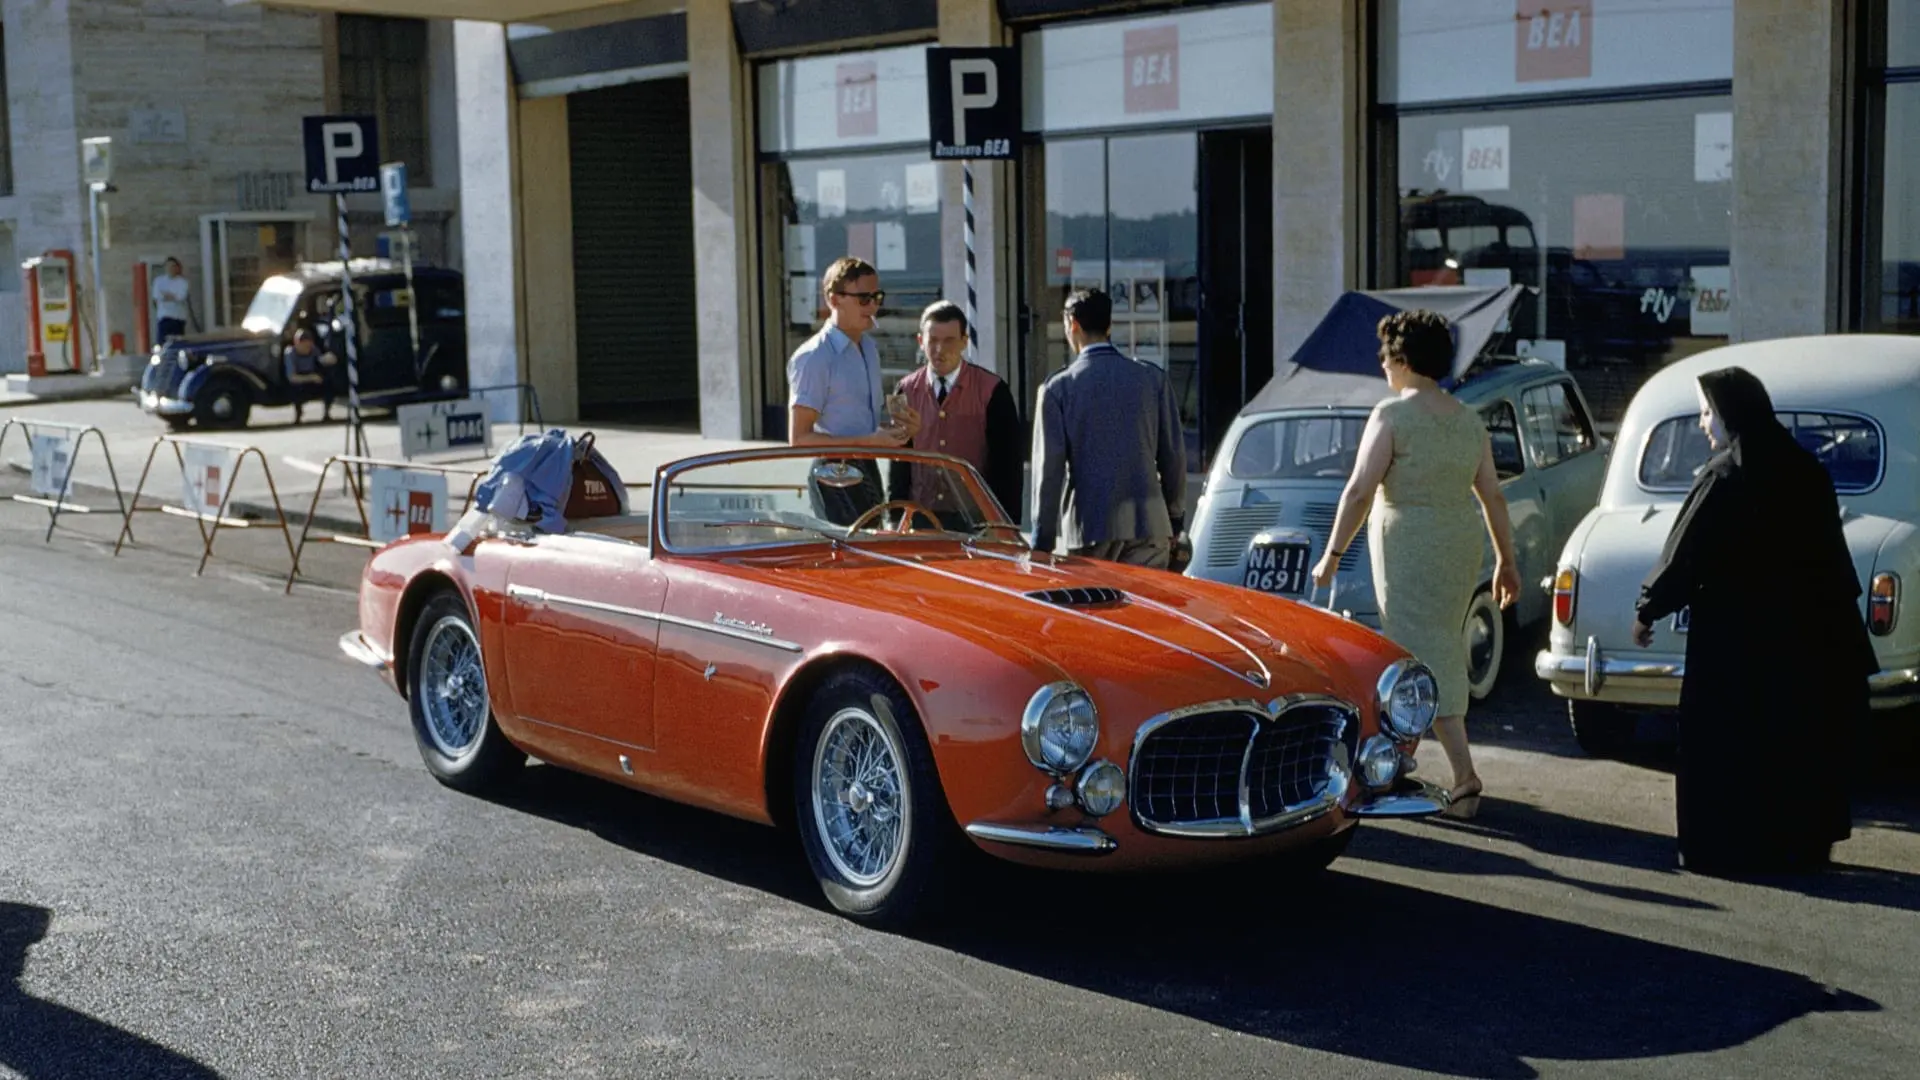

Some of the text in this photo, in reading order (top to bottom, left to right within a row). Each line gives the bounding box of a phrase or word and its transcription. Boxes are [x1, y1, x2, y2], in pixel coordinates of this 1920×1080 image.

[1526, 10, 1581, 51] BEA
[1131, 53, 1172, 87] BEA
[843, 88, 873, 114] BEA
[950, 58, 998, 147] P
[322, 122, 363, 184] P
[983, 138, 1010, 156] BEA
[1466, 147, 1503, 170] BEA
[1640, 287, 1677, 323] fly
[450, 418, 484, 440] BOAC
[1246, 569, 1301, 591] 0691
